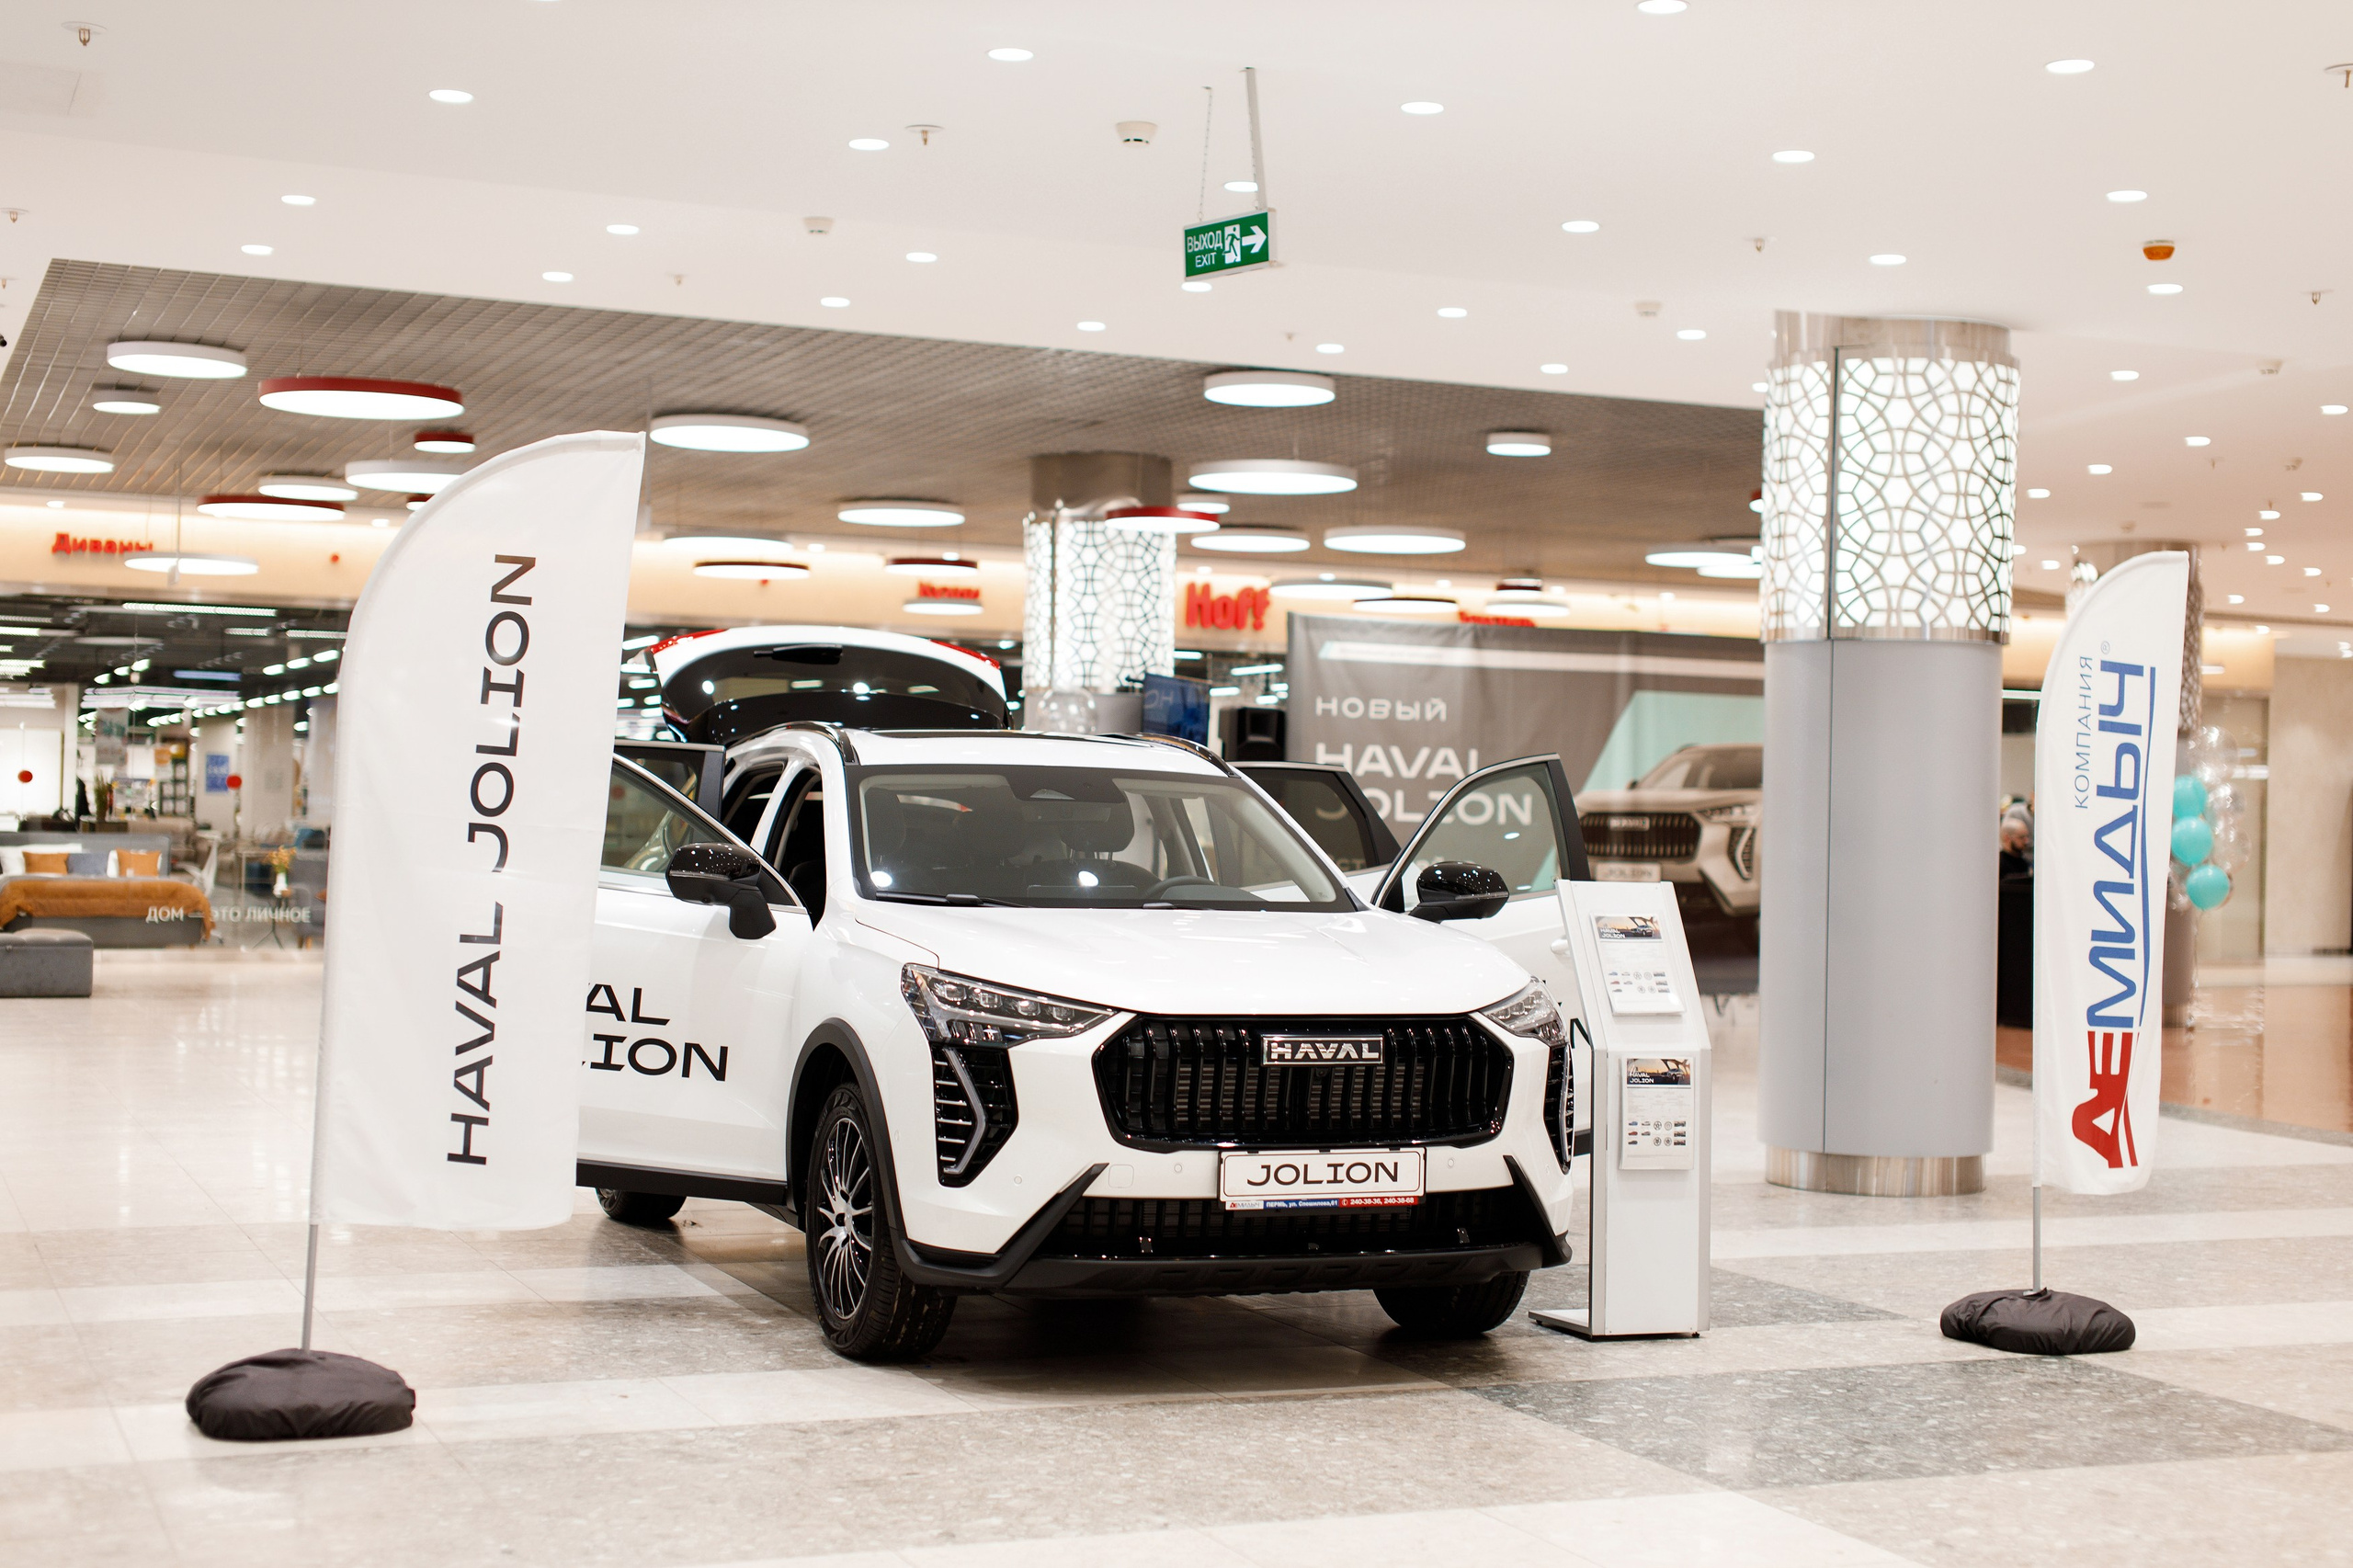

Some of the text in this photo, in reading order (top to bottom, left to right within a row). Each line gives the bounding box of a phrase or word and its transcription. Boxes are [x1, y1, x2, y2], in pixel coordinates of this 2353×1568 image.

[1187, 230, 1223, 253] ВЫХОД
[1195, 252, 1217, 267] EXIT
[51, 532, 153, 555] Диваны
[1186, 582, 1270, 631] Hoff
[1315, 697, 1447, 722] НОВЫЙ
[2074, 655, 2093, 810] КОМПАНИЯ
[447, 554, 536, 1165] HAVAL JOLION
[145, 905, 184, 924] ДОМ
[210, 906, 241, 922] ЭТО
[245, 906, 311, 924] ЛИЧНОЕ
[2072, 659, 2147, 1169] ДЕМИДЫЧ
[1270, 1042, 1380, 1060] HAVAL
[1246, 1162, 1398, 1186] JOLION
